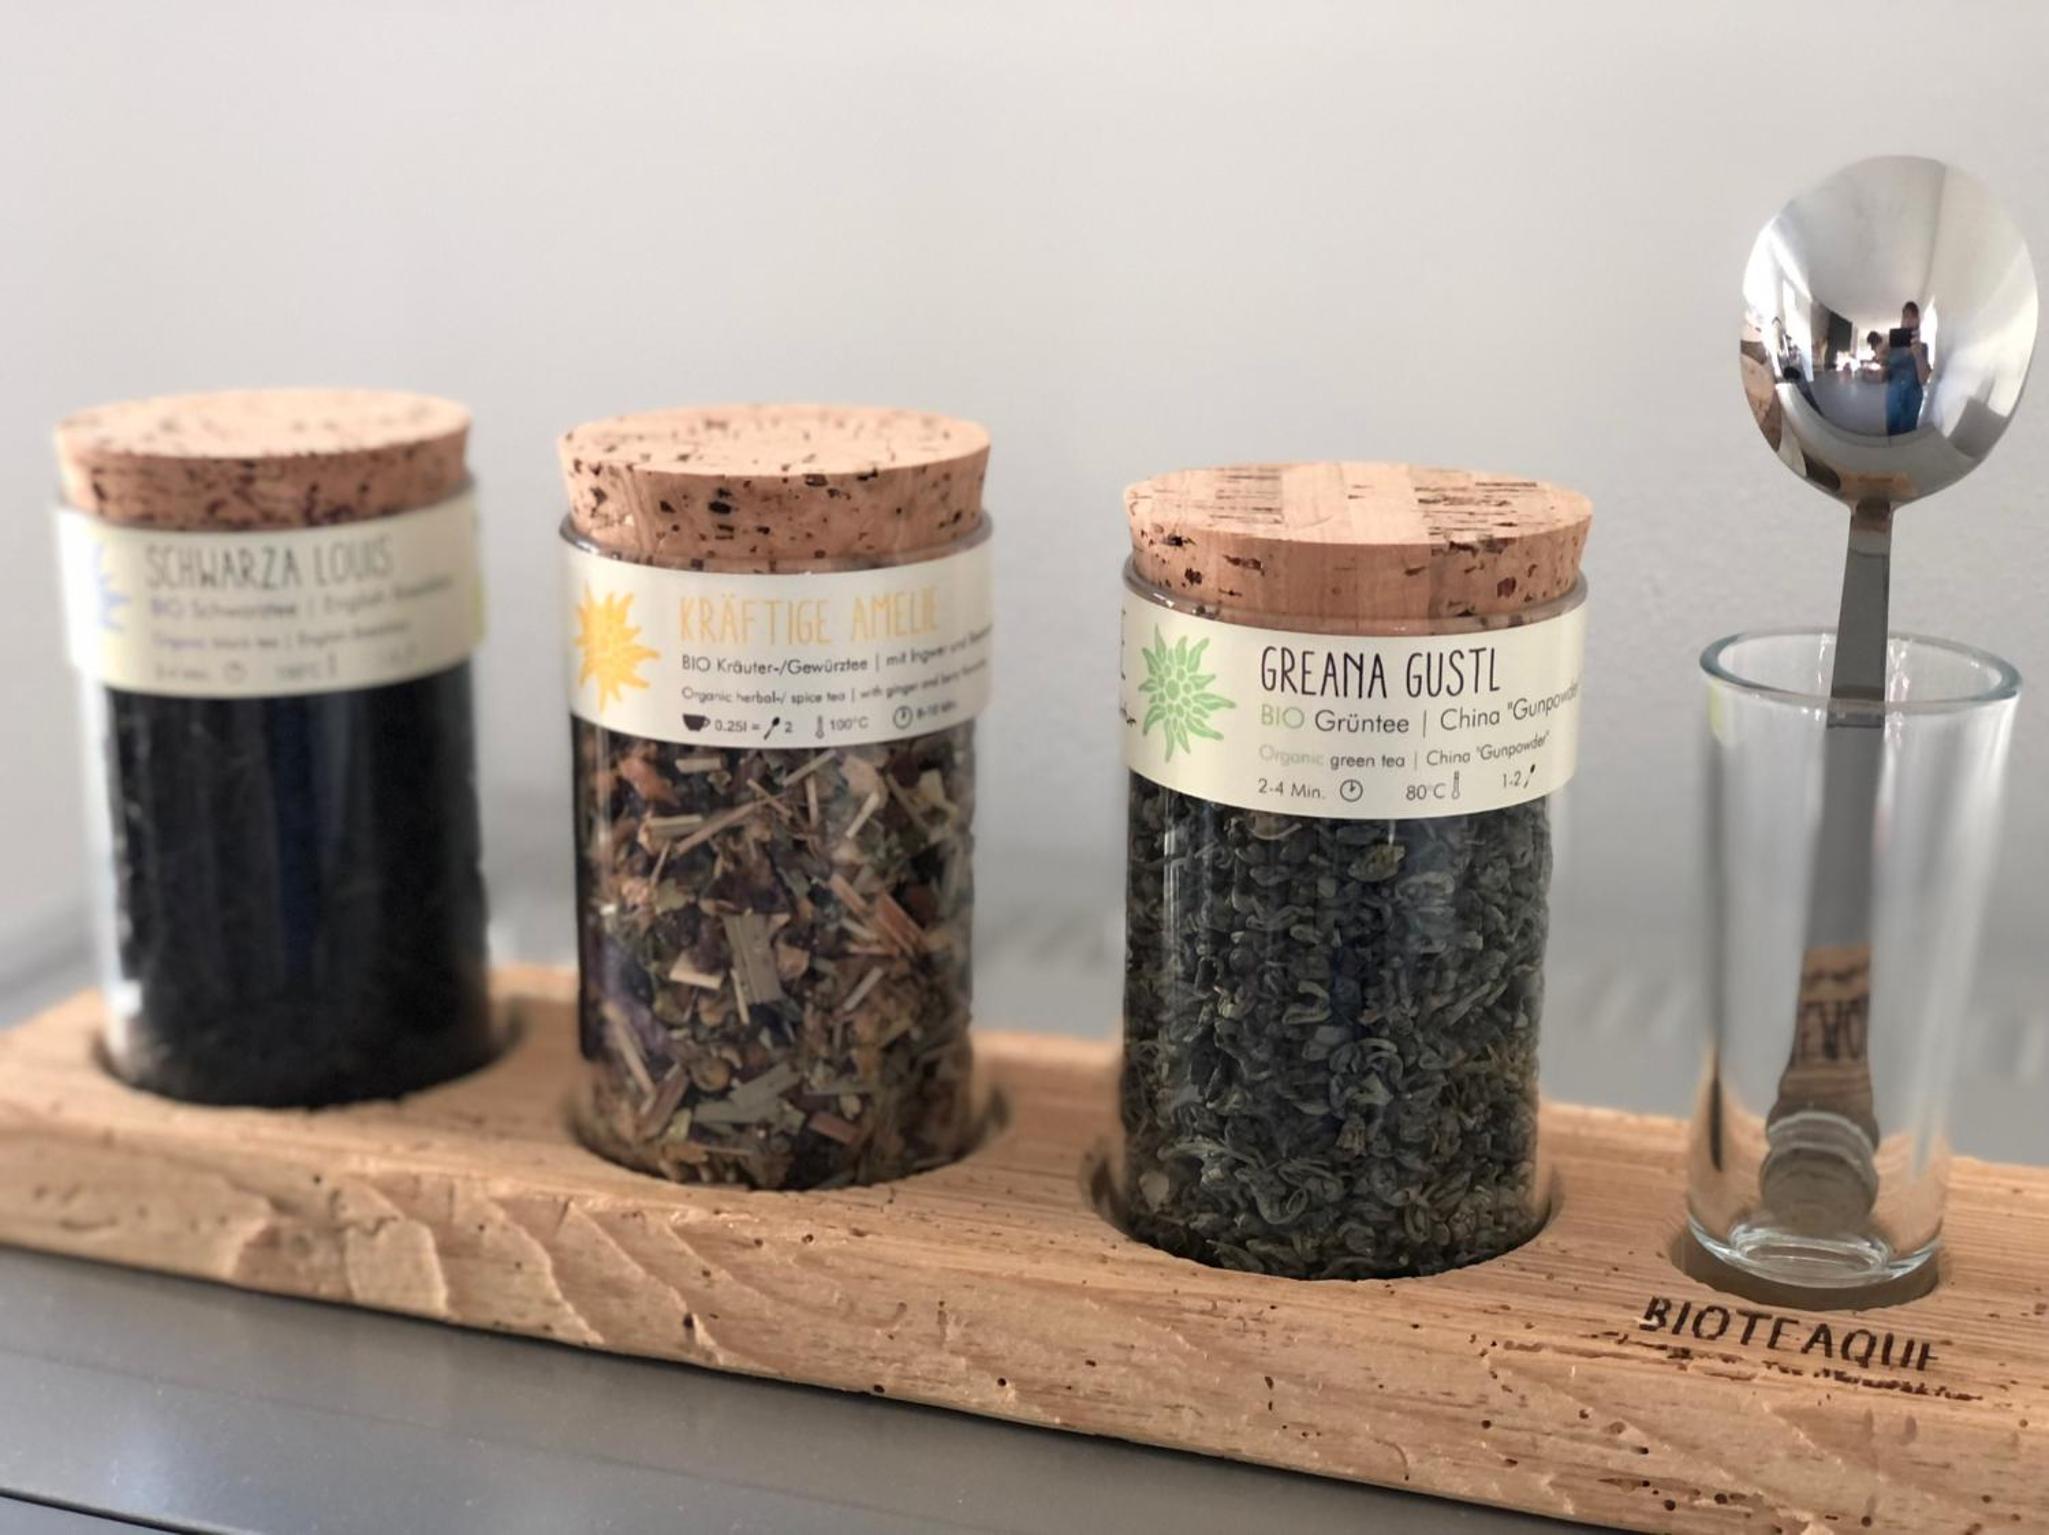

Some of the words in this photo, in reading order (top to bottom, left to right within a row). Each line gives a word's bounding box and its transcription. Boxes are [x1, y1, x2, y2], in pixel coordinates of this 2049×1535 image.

[145, 545, 302, 590] SCHWARZA
[315, 534, 394, 586] LOUIS
[680, 592, 832, 645] KRÄFTIGE
[849, 585, 938, 642] AMELIE
[682, 654, 711, 672] BIO
[886, 652, 906, 667] mit
[1261, 645, 1388, 699] GREANA
[1406, 647, 1501, 698] GUSTL
[681, 686, 732, 703] Organic
[791, 691, 822, 706] spice
[826, 691, 846, 702] tea
[1261, 703, 1305, 729] BIO
[1314, 709, 1410, 733] Grüntee
[1440, 706, 1501, 731] China
[1259, 744, 1326, 767] Organic
[1330, 754, 1375, 770] green
[1381, 754, 1406, 768] tea
[1426, 749, 1471, 766] China
[1258, 778, 1284, 795] 2-4
